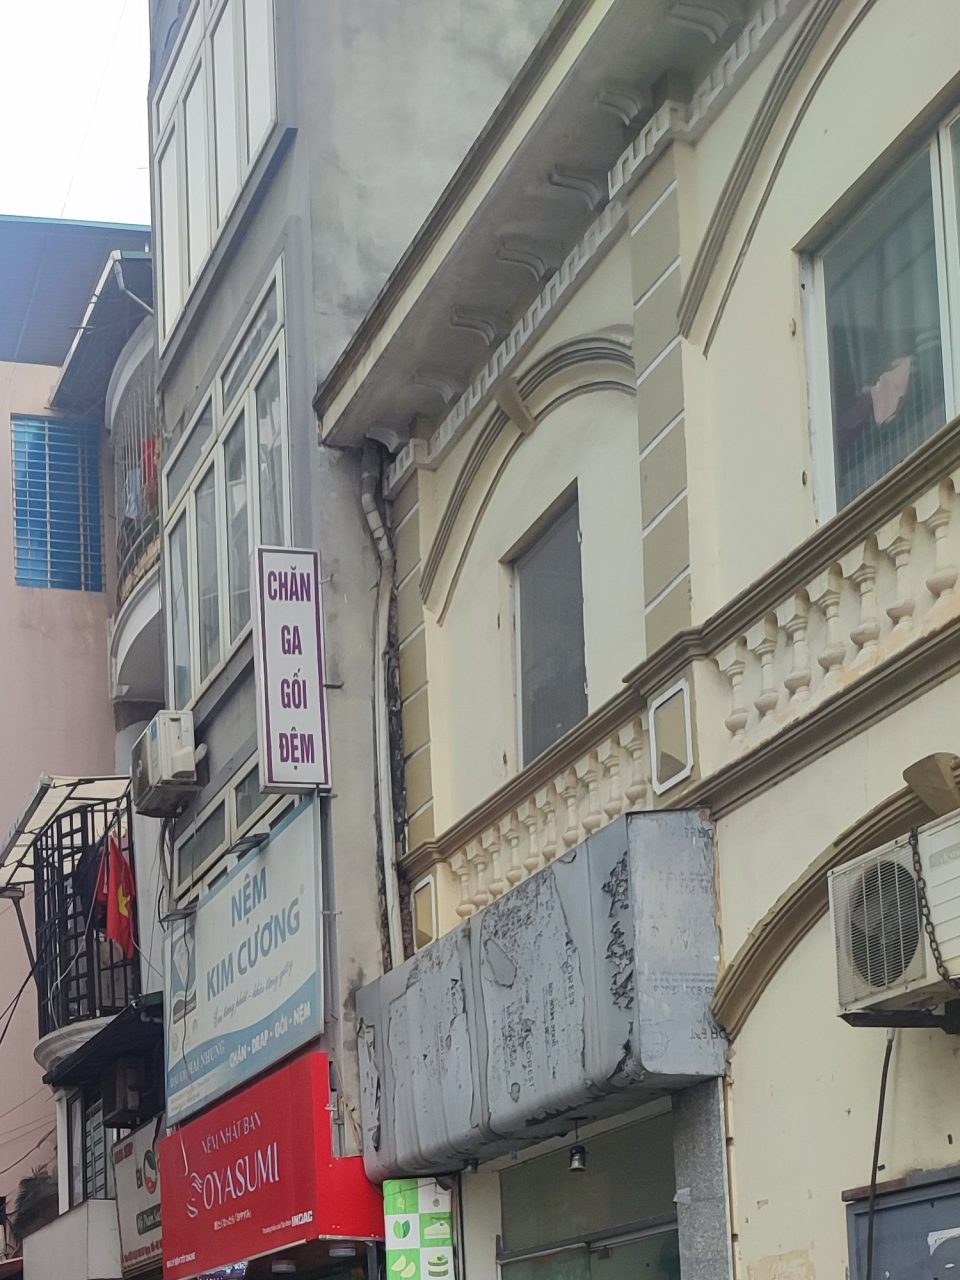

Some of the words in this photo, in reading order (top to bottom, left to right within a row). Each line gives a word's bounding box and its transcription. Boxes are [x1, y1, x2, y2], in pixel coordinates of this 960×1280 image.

[267, 565, 311, 602] CHĂN
[280, 624, 303, 656] GA
[280, 668, 308, 709] GỐI
[278, 727, 315, 771] ĐỆM
[230, 866, 268, 928] NỆM
[206, 951, 234, 1002] KIM
[236, 897, 301, 977] CƯƠNG
[202, 1142, 280, 1211] OYASUMI
